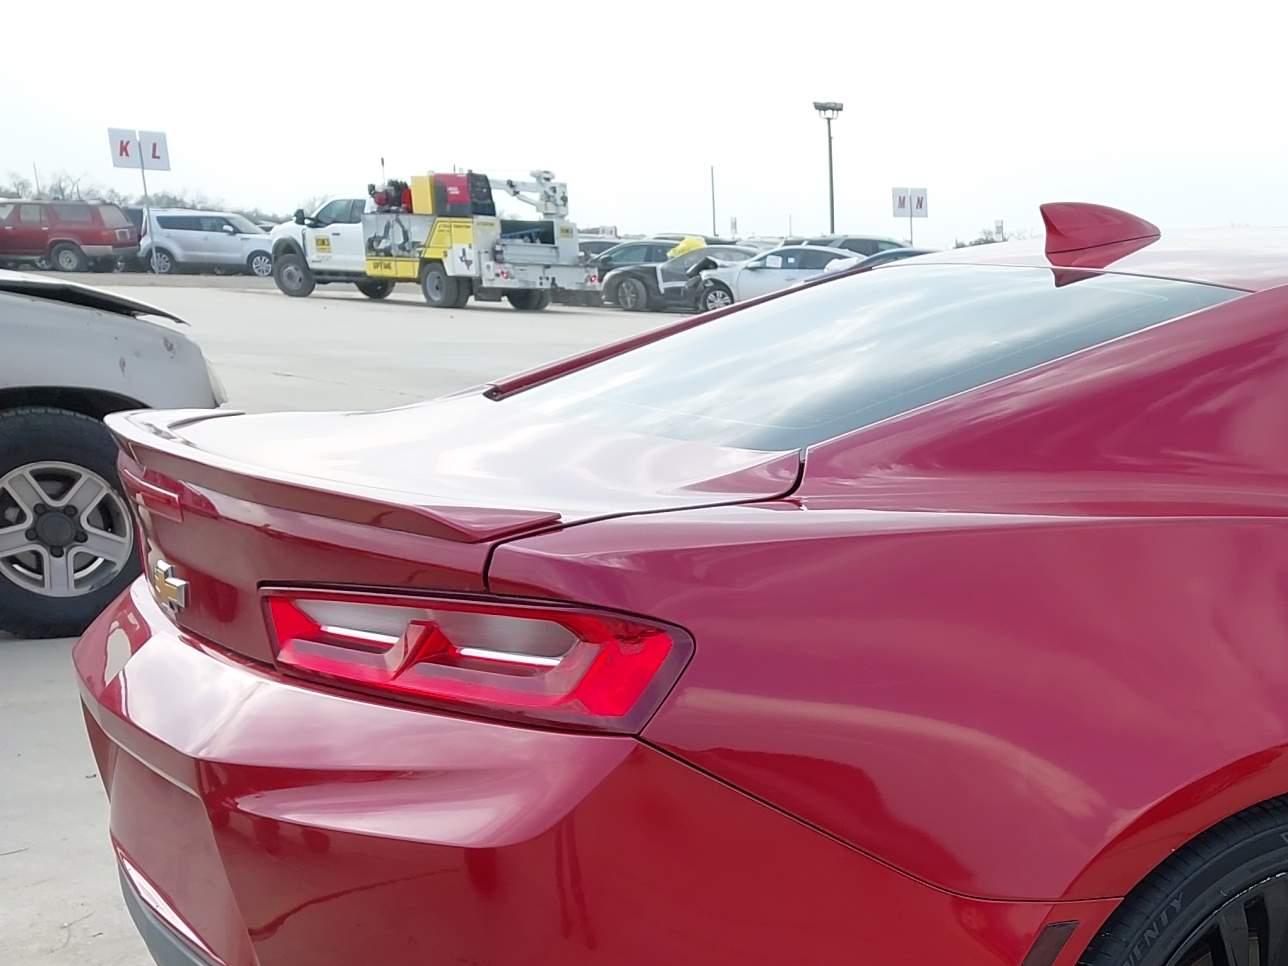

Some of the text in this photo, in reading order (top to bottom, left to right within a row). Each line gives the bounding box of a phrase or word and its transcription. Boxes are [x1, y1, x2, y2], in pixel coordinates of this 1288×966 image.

[119, 139, 130, 157] K
[151, 141, 161, 159] L
[897, 195, 906, 209] M
[915, 195, 924, 209] N
